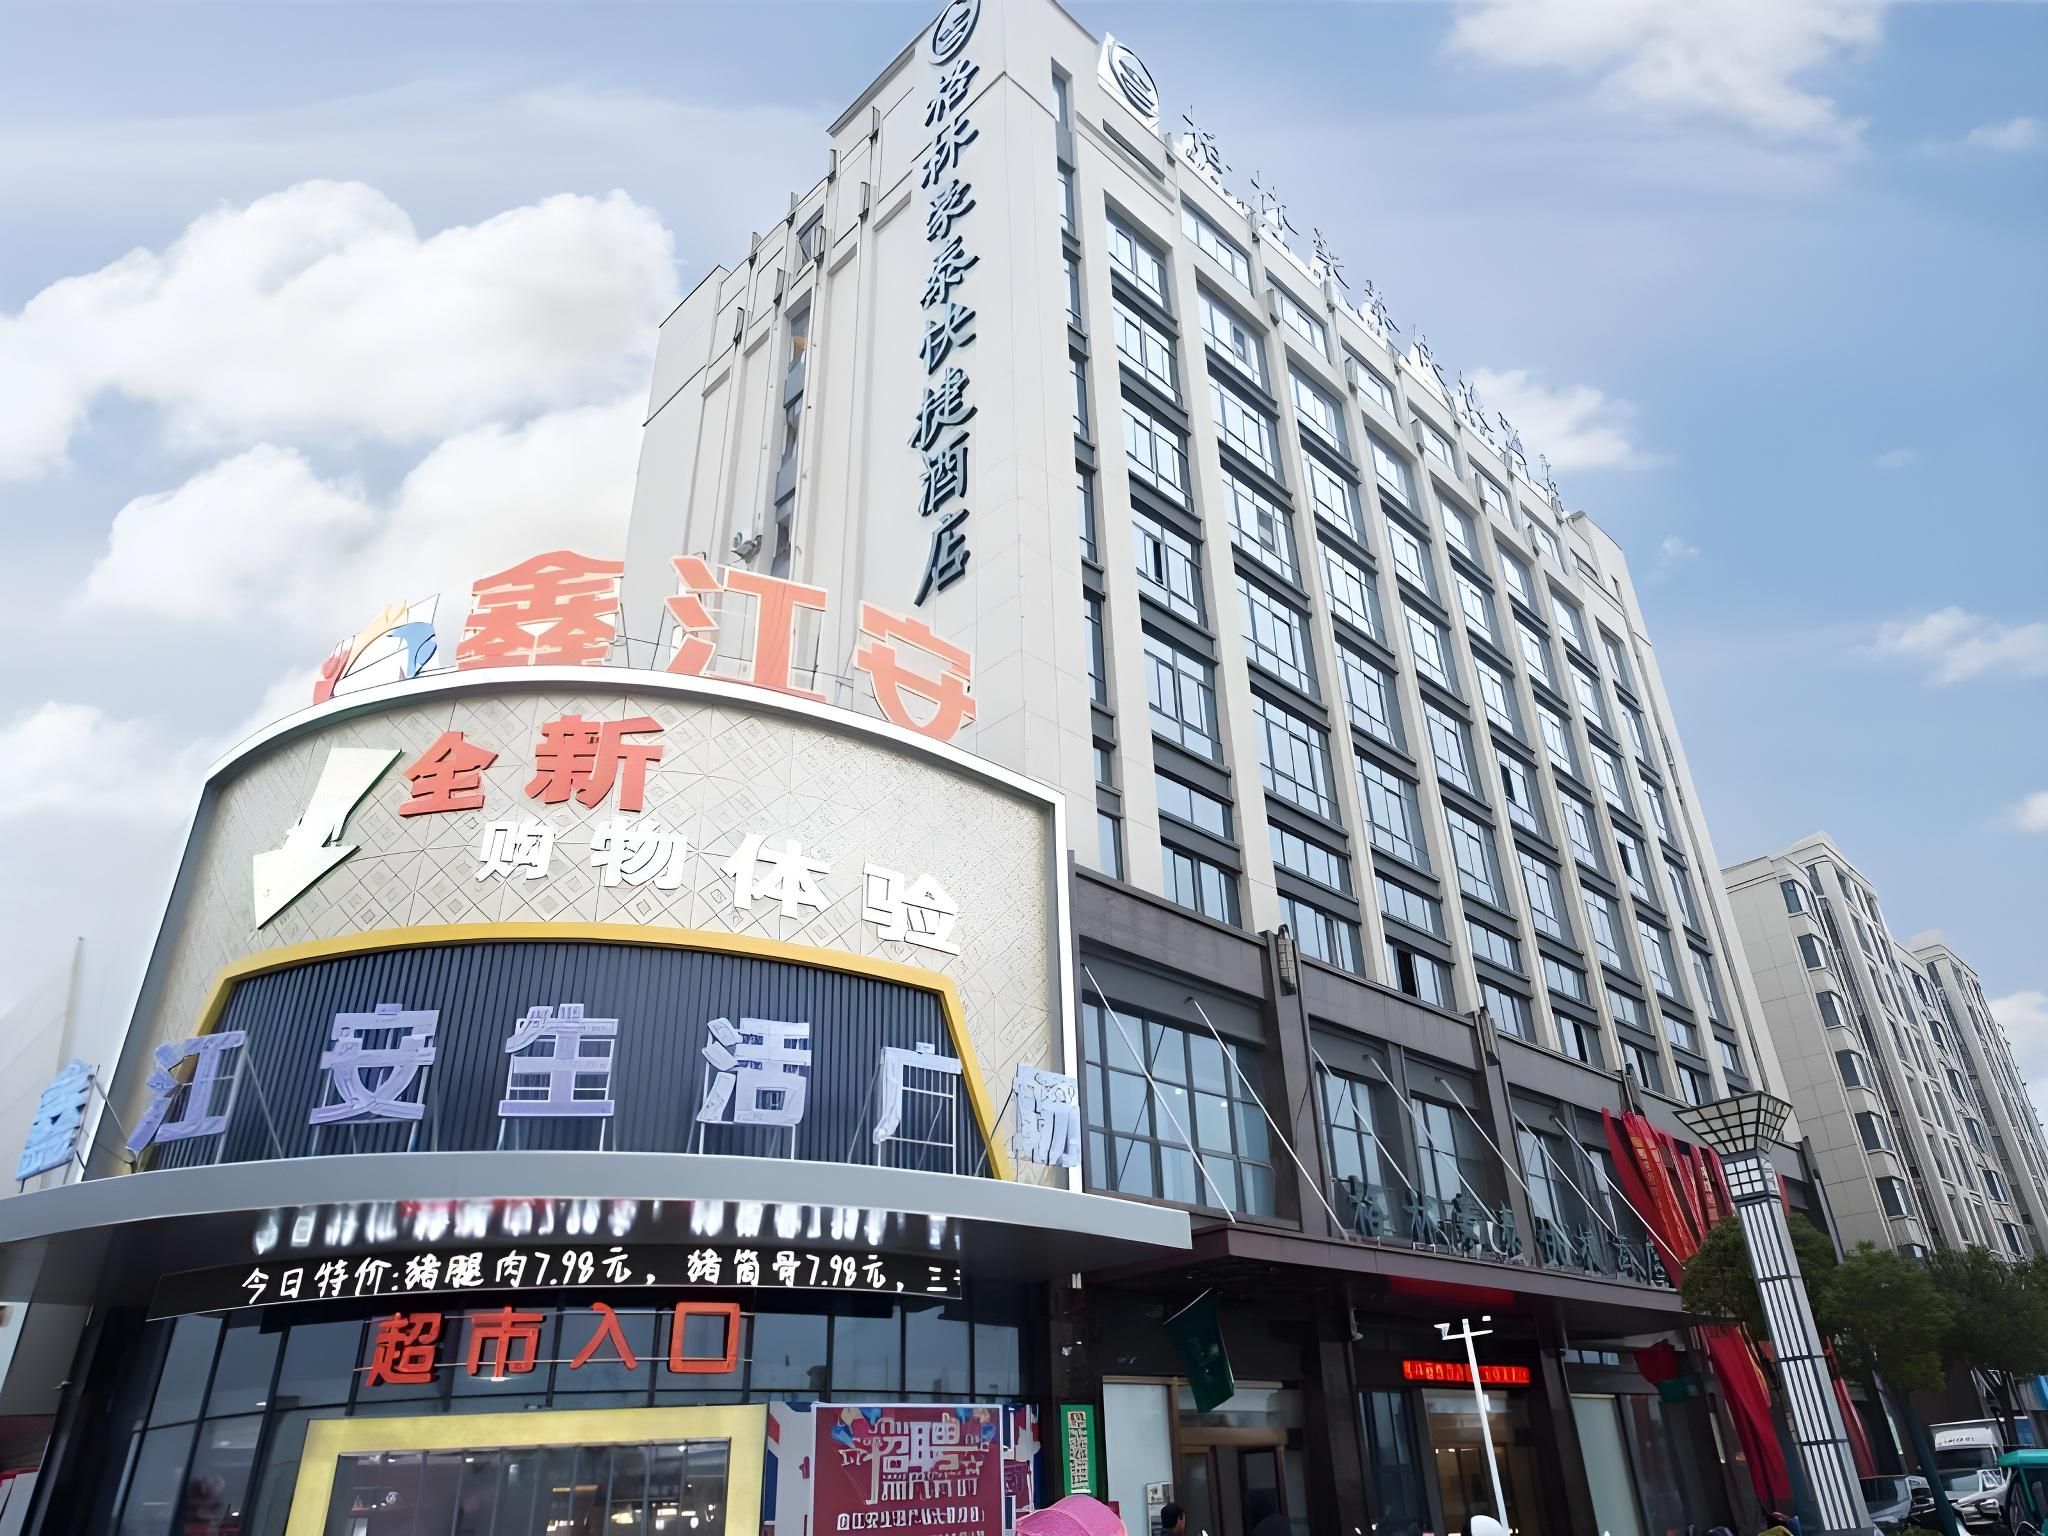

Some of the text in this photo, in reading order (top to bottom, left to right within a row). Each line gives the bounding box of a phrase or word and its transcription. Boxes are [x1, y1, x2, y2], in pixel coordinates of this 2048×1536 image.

[456, 550, 977, 742] 鑫江安
[398, 714, 664, 817] 全新
[475, 813, 960, 956] 购物体验
[365, 1301, 741, 1387] 超市入口
